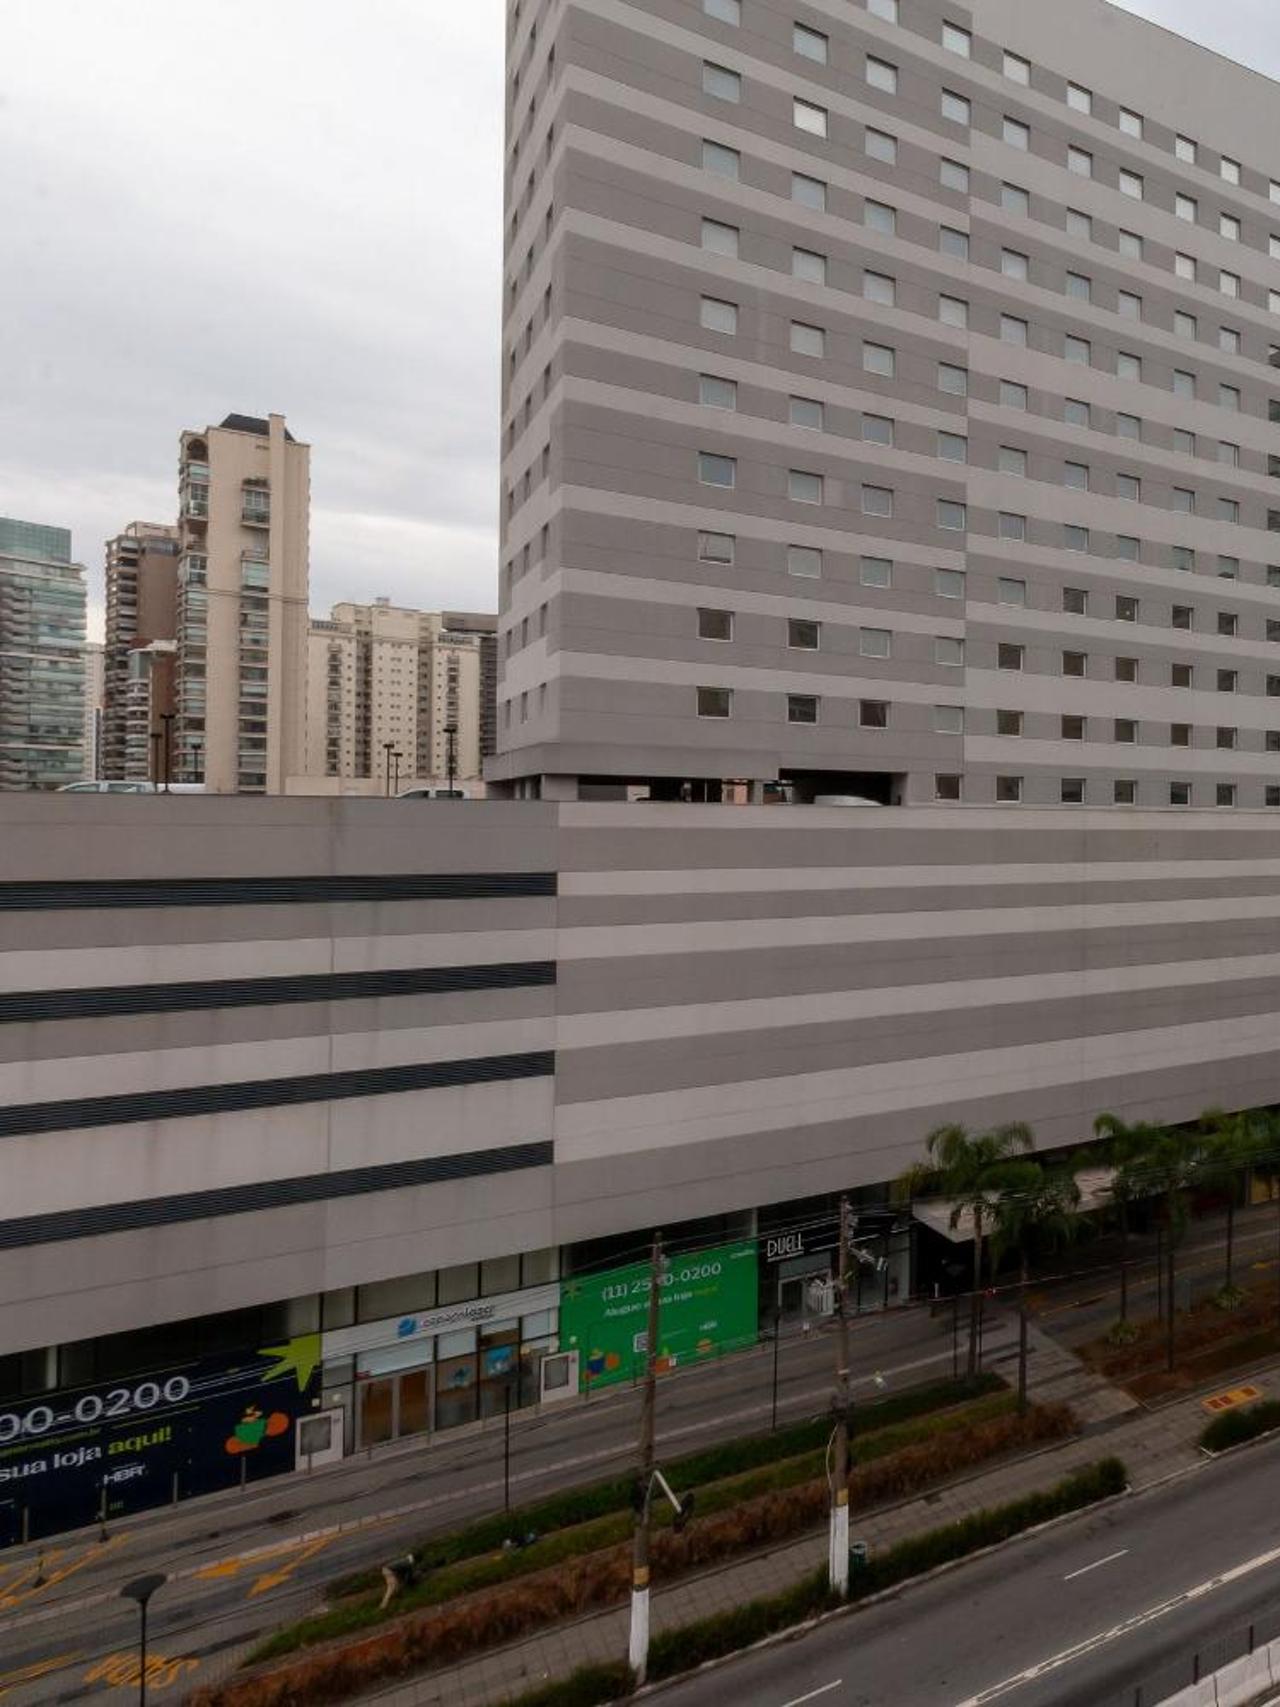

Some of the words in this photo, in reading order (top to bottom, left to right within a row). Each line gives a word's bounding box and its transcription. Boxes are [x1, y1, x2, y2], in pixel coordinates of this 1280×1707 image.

[631, 1262, 722, 1294] 250-0200
[54, 1447, 102, 1469] loja
[108, 1426, 172, 1455] aqui!
